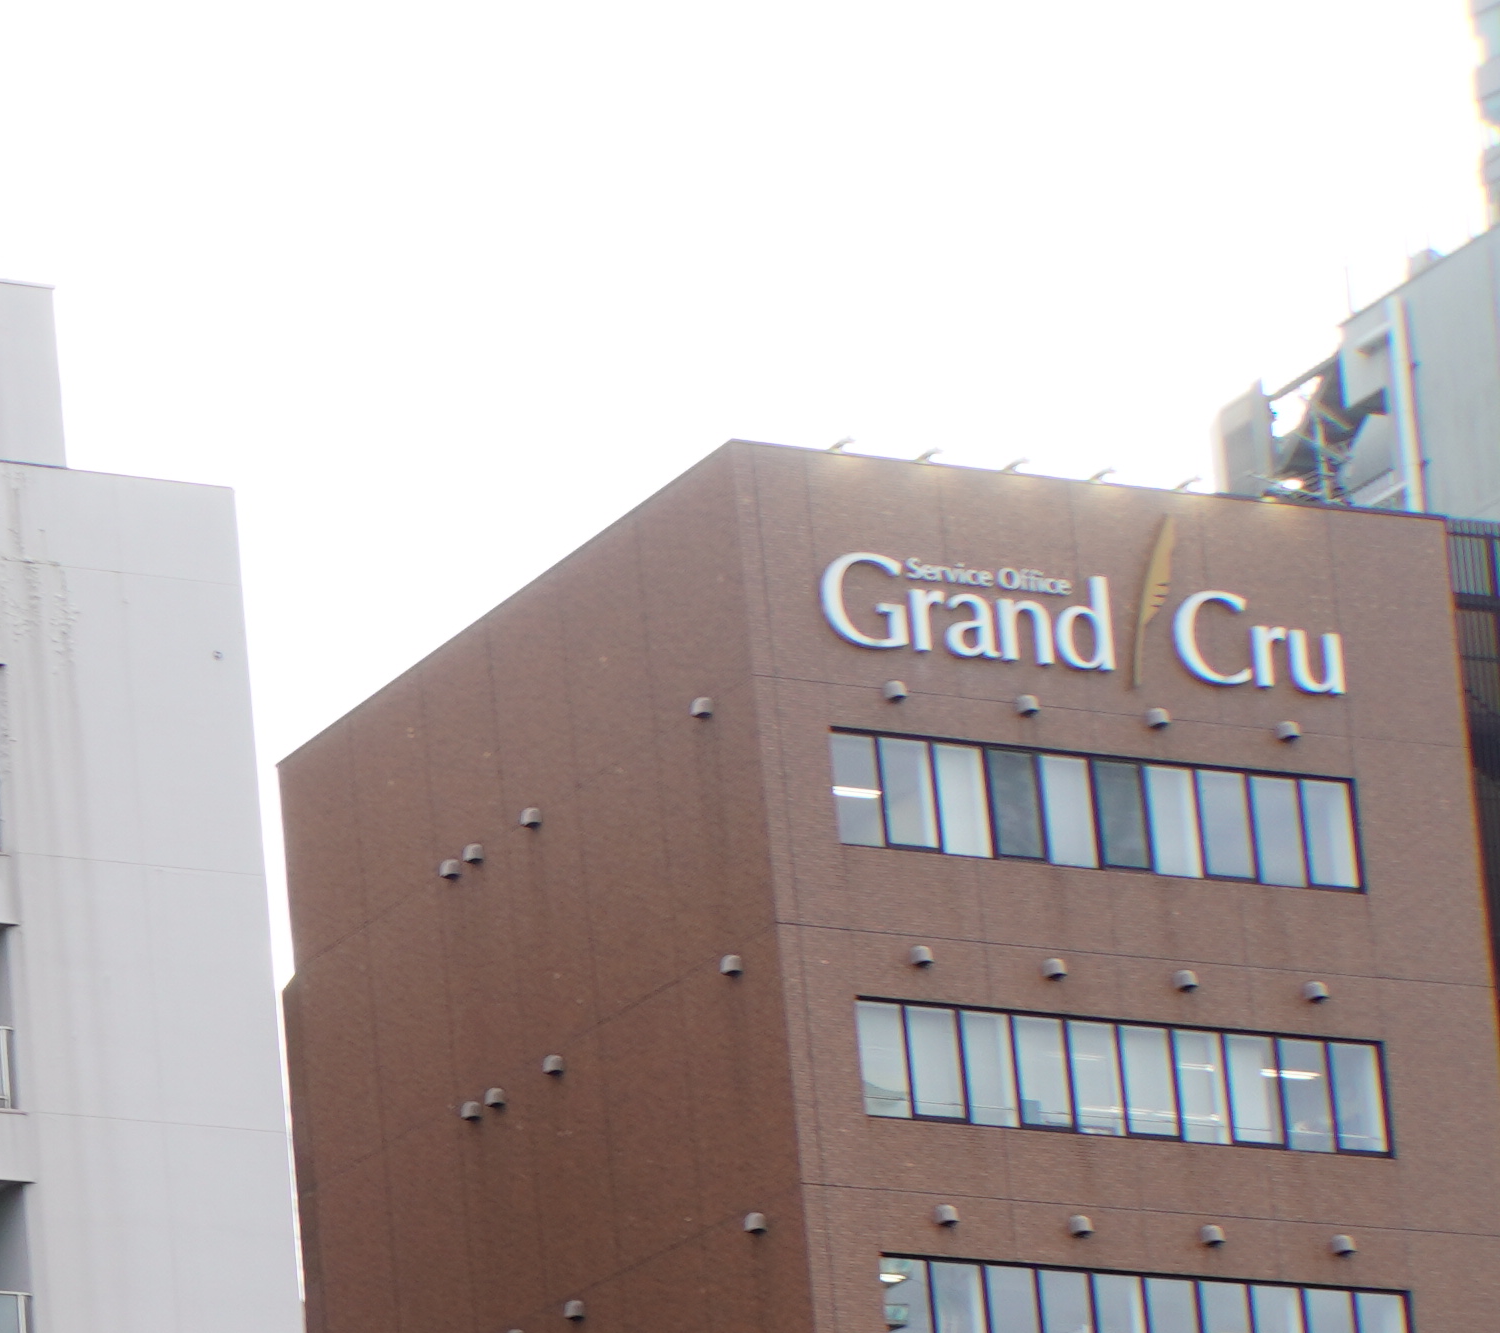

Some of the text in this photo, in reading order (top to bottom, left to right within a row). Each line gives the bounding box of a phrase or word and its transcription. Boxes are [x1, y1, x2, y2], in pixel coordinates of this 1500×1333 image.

[904, 556, 1073, 596] Service Office
[820, 552, 1346, 695] Grand Cru
